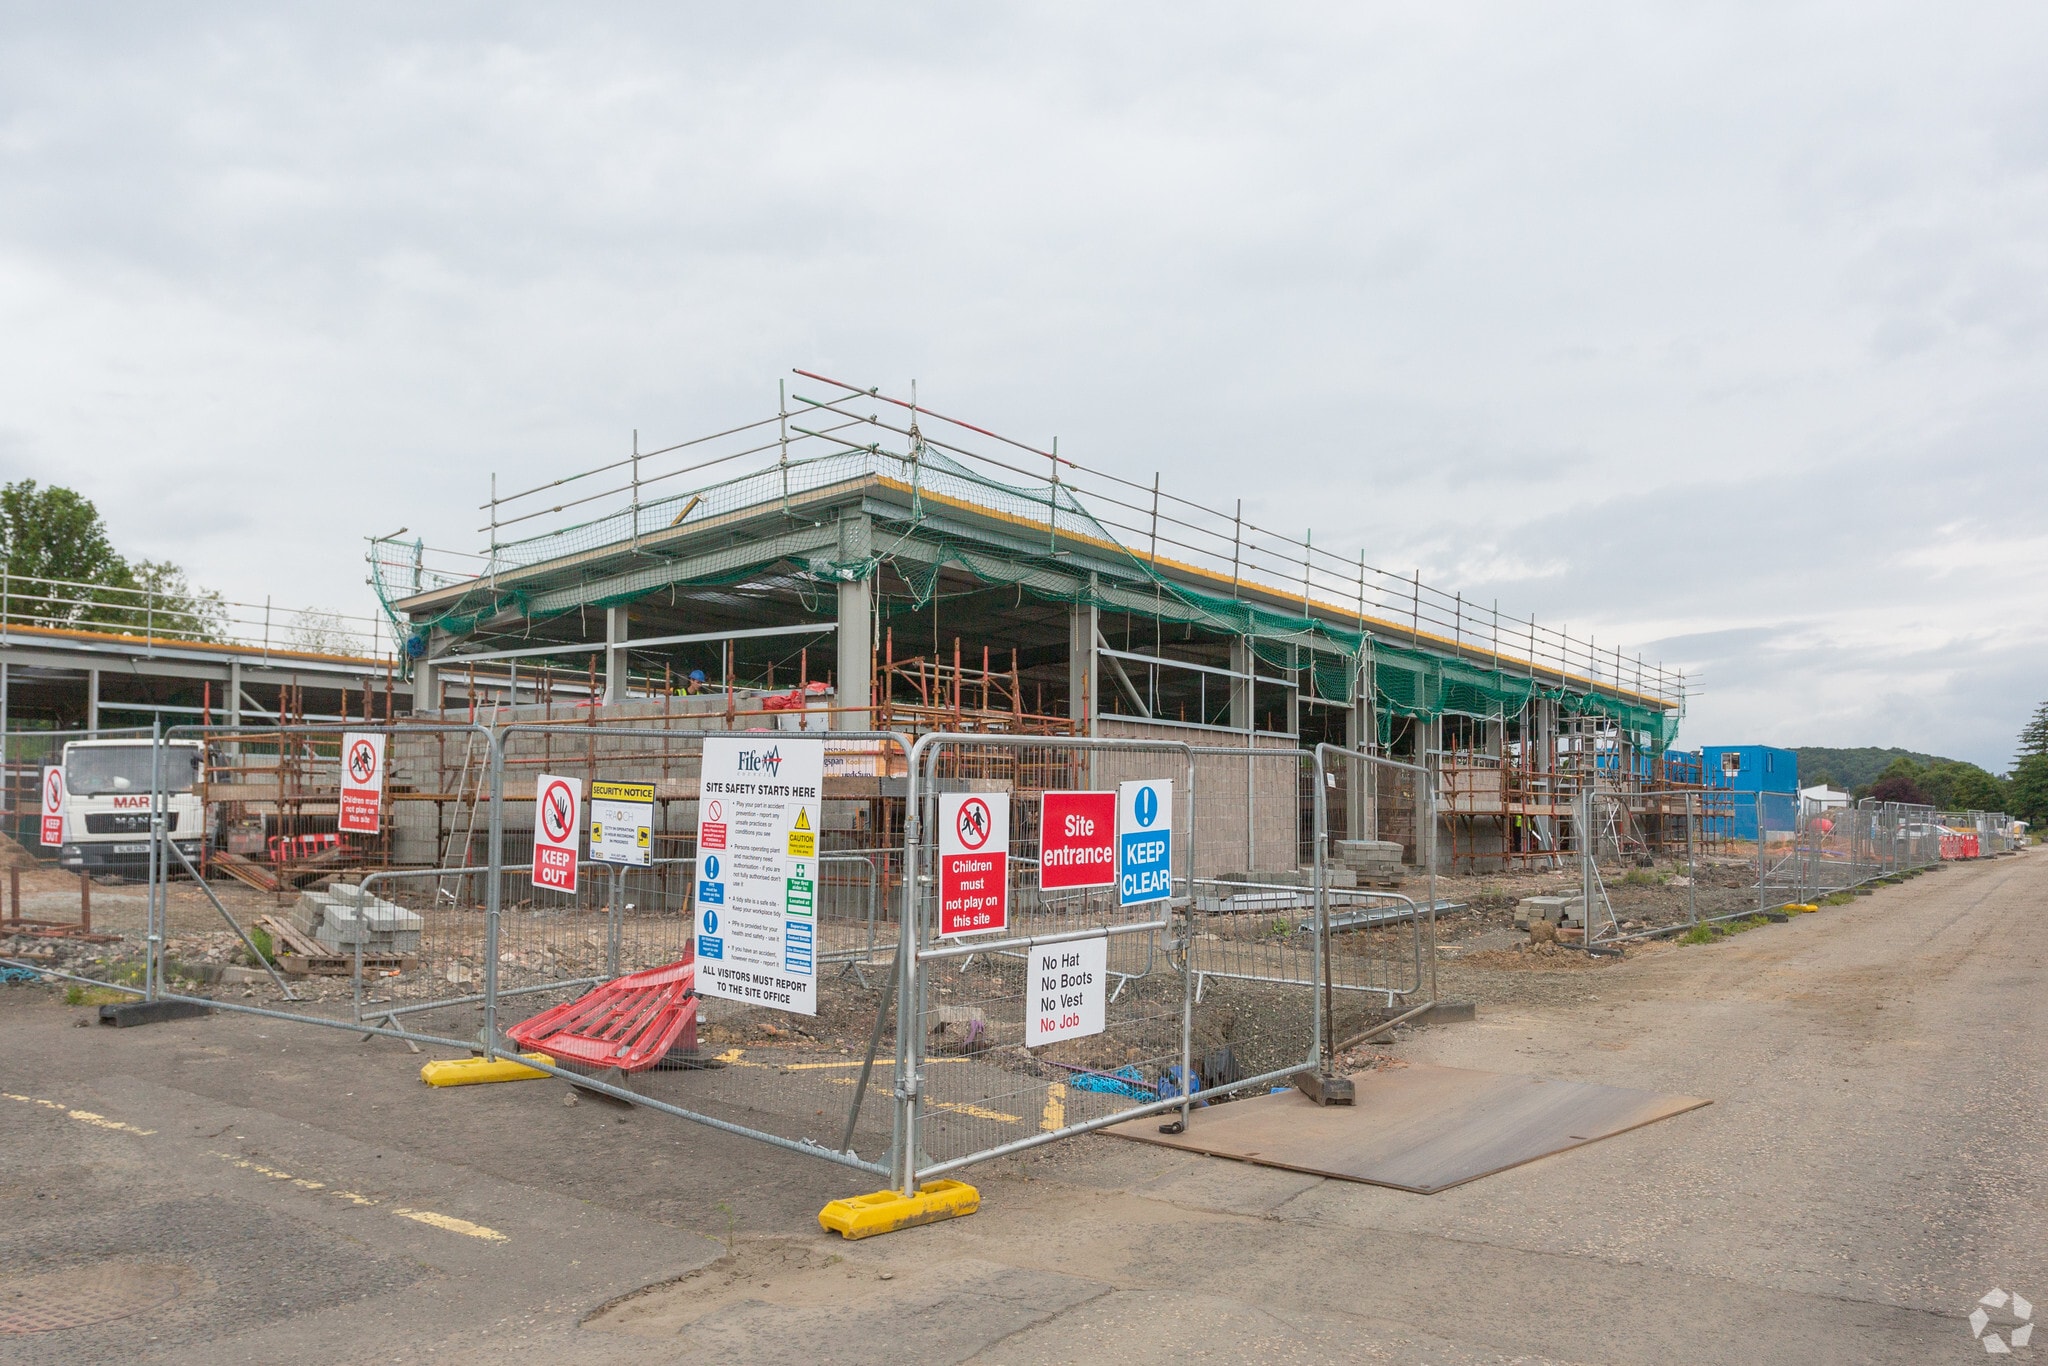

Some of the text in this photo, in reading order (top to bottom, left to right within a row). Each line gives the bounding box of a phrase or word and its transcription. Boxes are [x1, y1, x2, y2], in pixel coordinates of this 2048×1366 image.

[738, 750, 760, 771] Fife
[824, 758, 843, 767] gspan
[594, 786, 653, 797] SECURITY NOTICE
[706, 782, 815, 797] SITE SAFETY STARTS HERE
[343, 796, 364, 804] Children
[356, 807, 366, 815] play
[45, 818, 60, 829] KEEP
[1065, 814, 1094, 837] Site
[46, 830, 58, 842] OUT
[790, 834, 813, 843] CAUTION
[542, 850, 569, 867] KEEP
[1044, 845, 1113, 867] entrance
[1127, 841, 1165, 865] KEEP
[952, 861, 992, 874] Children
[543, 868, 567, 885] OUT
[960, 878, 984, 890] must
[1123, 870, 1170, 896] CLEAR
[946, 896, 997, 911] not play on
[953, 913, 990, 927] this site
[1042, 953, 1080, 971] No Hat
[703, 965, 807, 992] ALL VISITORS MUST REPORT
[1042, 971, 1092, 991] No Boots
[717, 981, 790, 1004] TO THE SITE OFFICE
[1041, 992, 1083, 1012] No Vest
[1041, 1013, 1079, 1033] No Job
